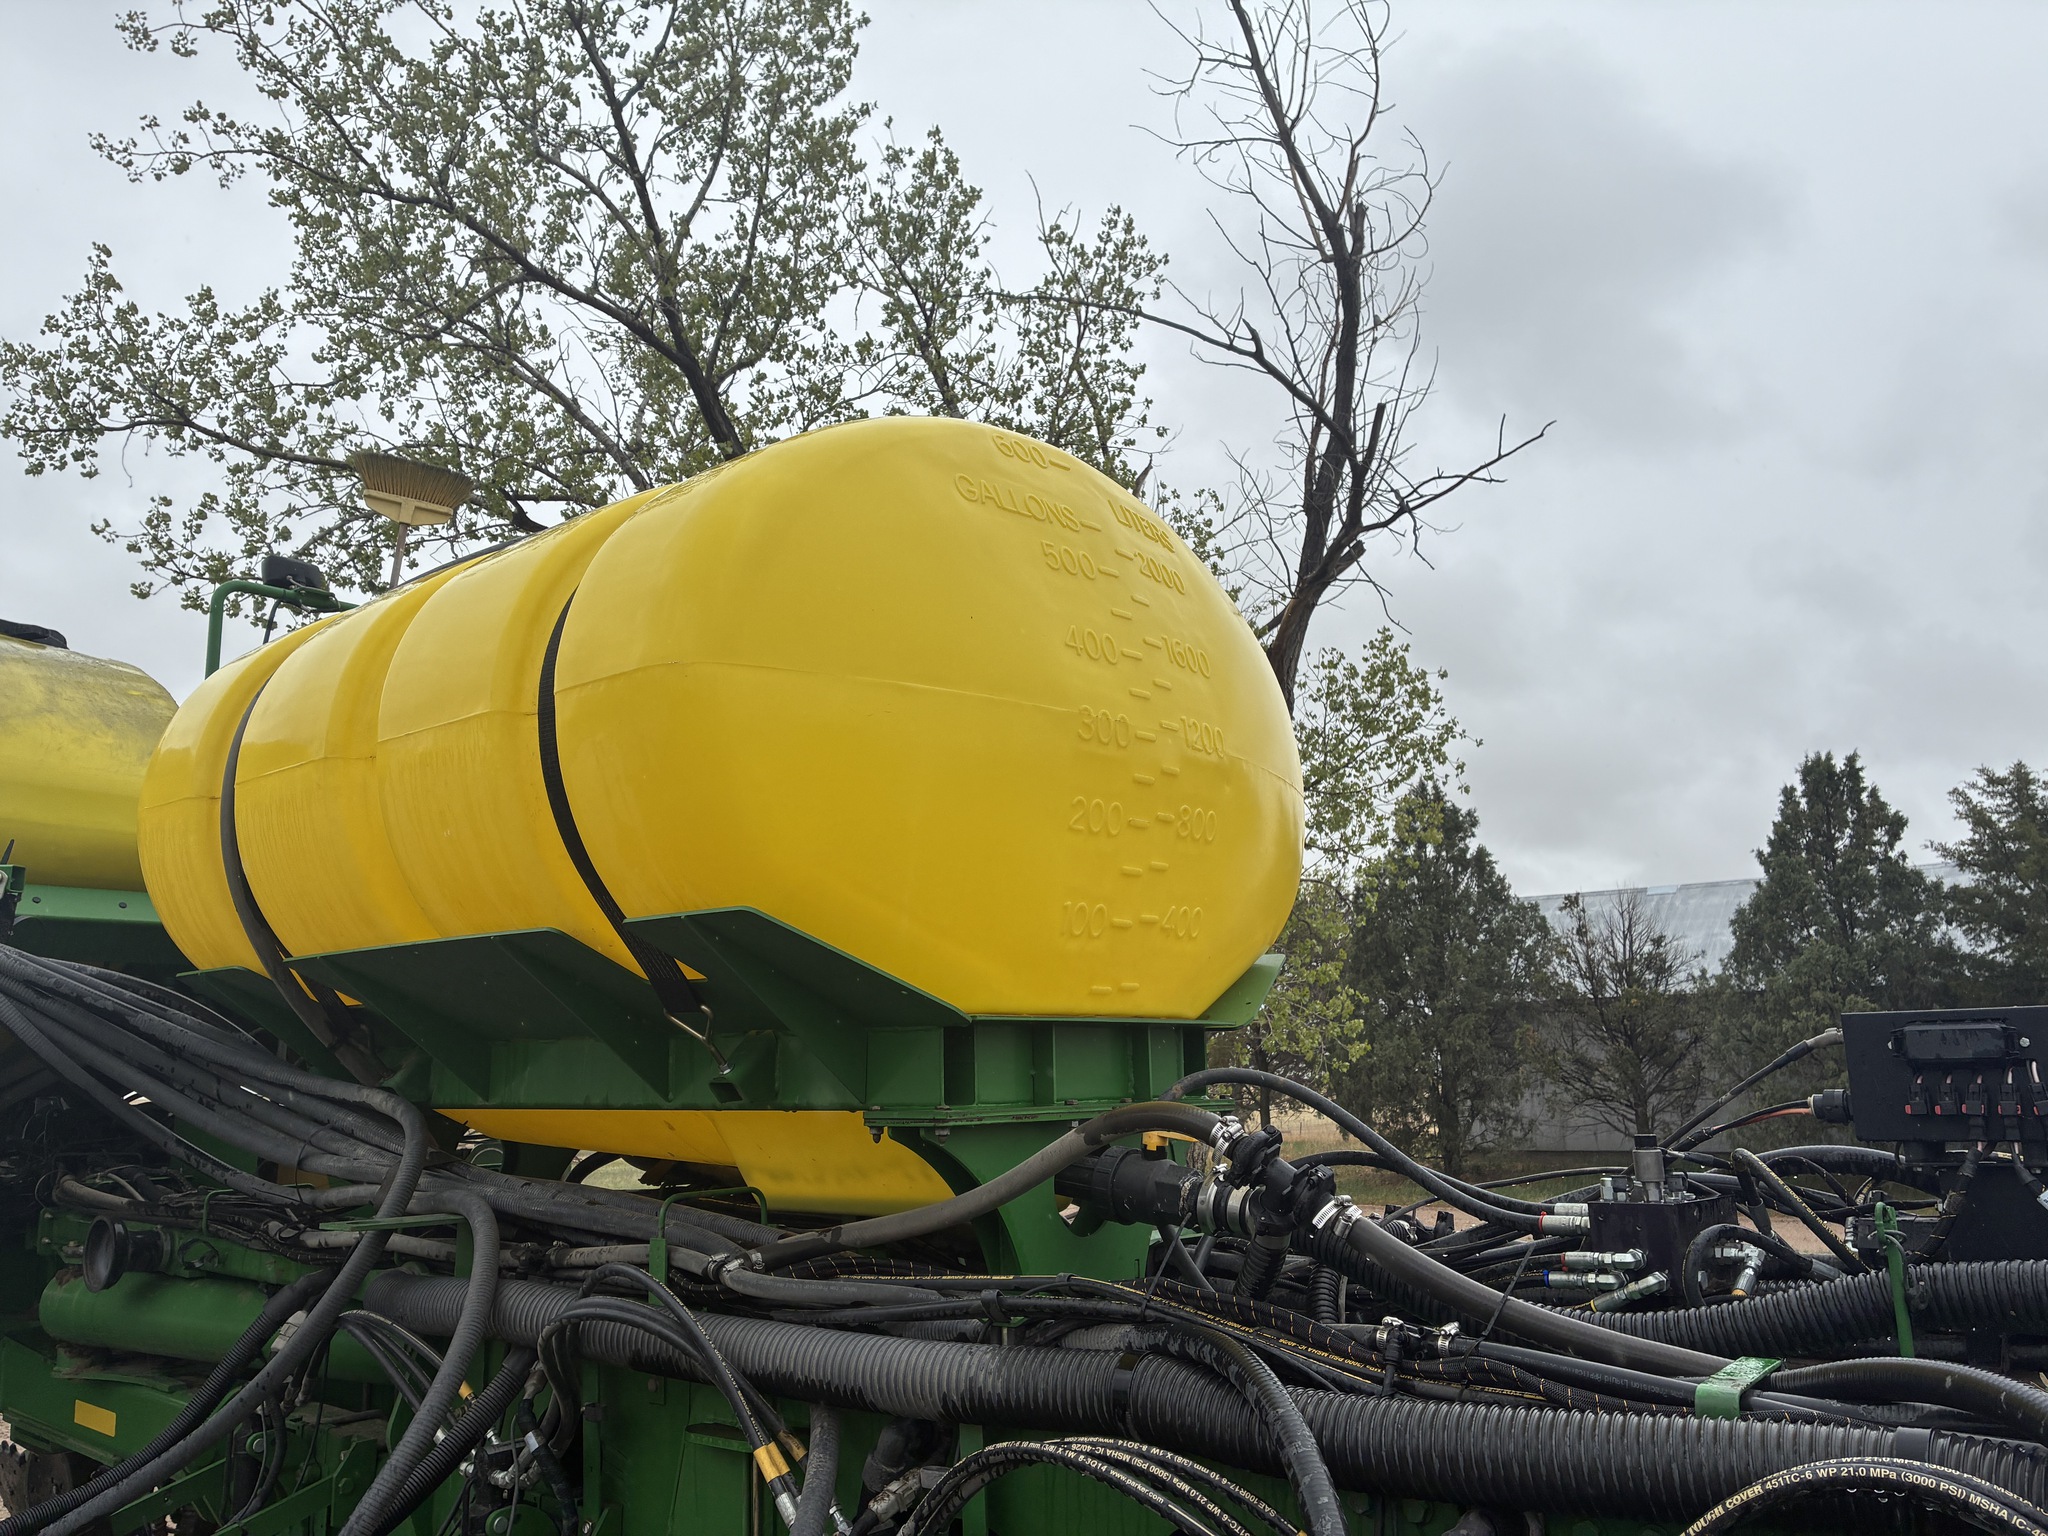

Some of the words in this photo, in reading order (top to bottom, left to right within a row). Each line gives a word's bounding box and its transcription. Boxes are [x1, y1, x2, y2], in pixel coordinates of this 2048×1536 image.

[992, 433, 1048, 469] 600
[955, 473, 1080, 532] GALLONS
[1108, 500, 1175, 553] LITERS
[1041, 540, 1096, 580] 500
[1134, 551, 1185, 595] 2000
[1065, 625, 1118, 665] 400
[1161, 635, 1210, 678] 1600
[1078, 705, 1130, 747] 300
[1180, 716, 1225, 758] 1200
[1069, 796, 1123, 836] 200
[1177, 805, 1217, 841] 800
[1062, 901, 1107, 937] 100
[1162, 906, 1203, 938] 400
[1070, 1443, 1105, 1454] IC-40/26
[1106, 1448, 1131, 1462] MSHA
[1131, 1457, 1149, 1470] PSI)
[1150, 1447, 1165, 1456] 1W
[1166, 1451, 1174, 1460] X
[1174, 1455, 1192, 1467] (3/8)
[1064, 1449, 1077, 1459] 1W
[1109, 1469, 1164, 1504] www.parker.com
[1149, 1465, 1172, 1481] (3000
[1173, 1477, 1191, 1493] MPa
[1193, 1463, 1209, 1474] mm
[1209, 1471, 1220, 1480] 10
[1206, 1504, 1221, 1517] WP
[1725, 1484, 1764, 1510] COVER
[1765, 1470, 1813, 1490] 451TC-6
[1816, 1467, 1837, 1478] WP
[1870, 1467, 1897, 1479] MPa
[1901, 1471, 1936, 1489] (3000
[1939, 1481, 1966, 1500] PSI)
[1968, 1493, 2008, 1520] MSHA
